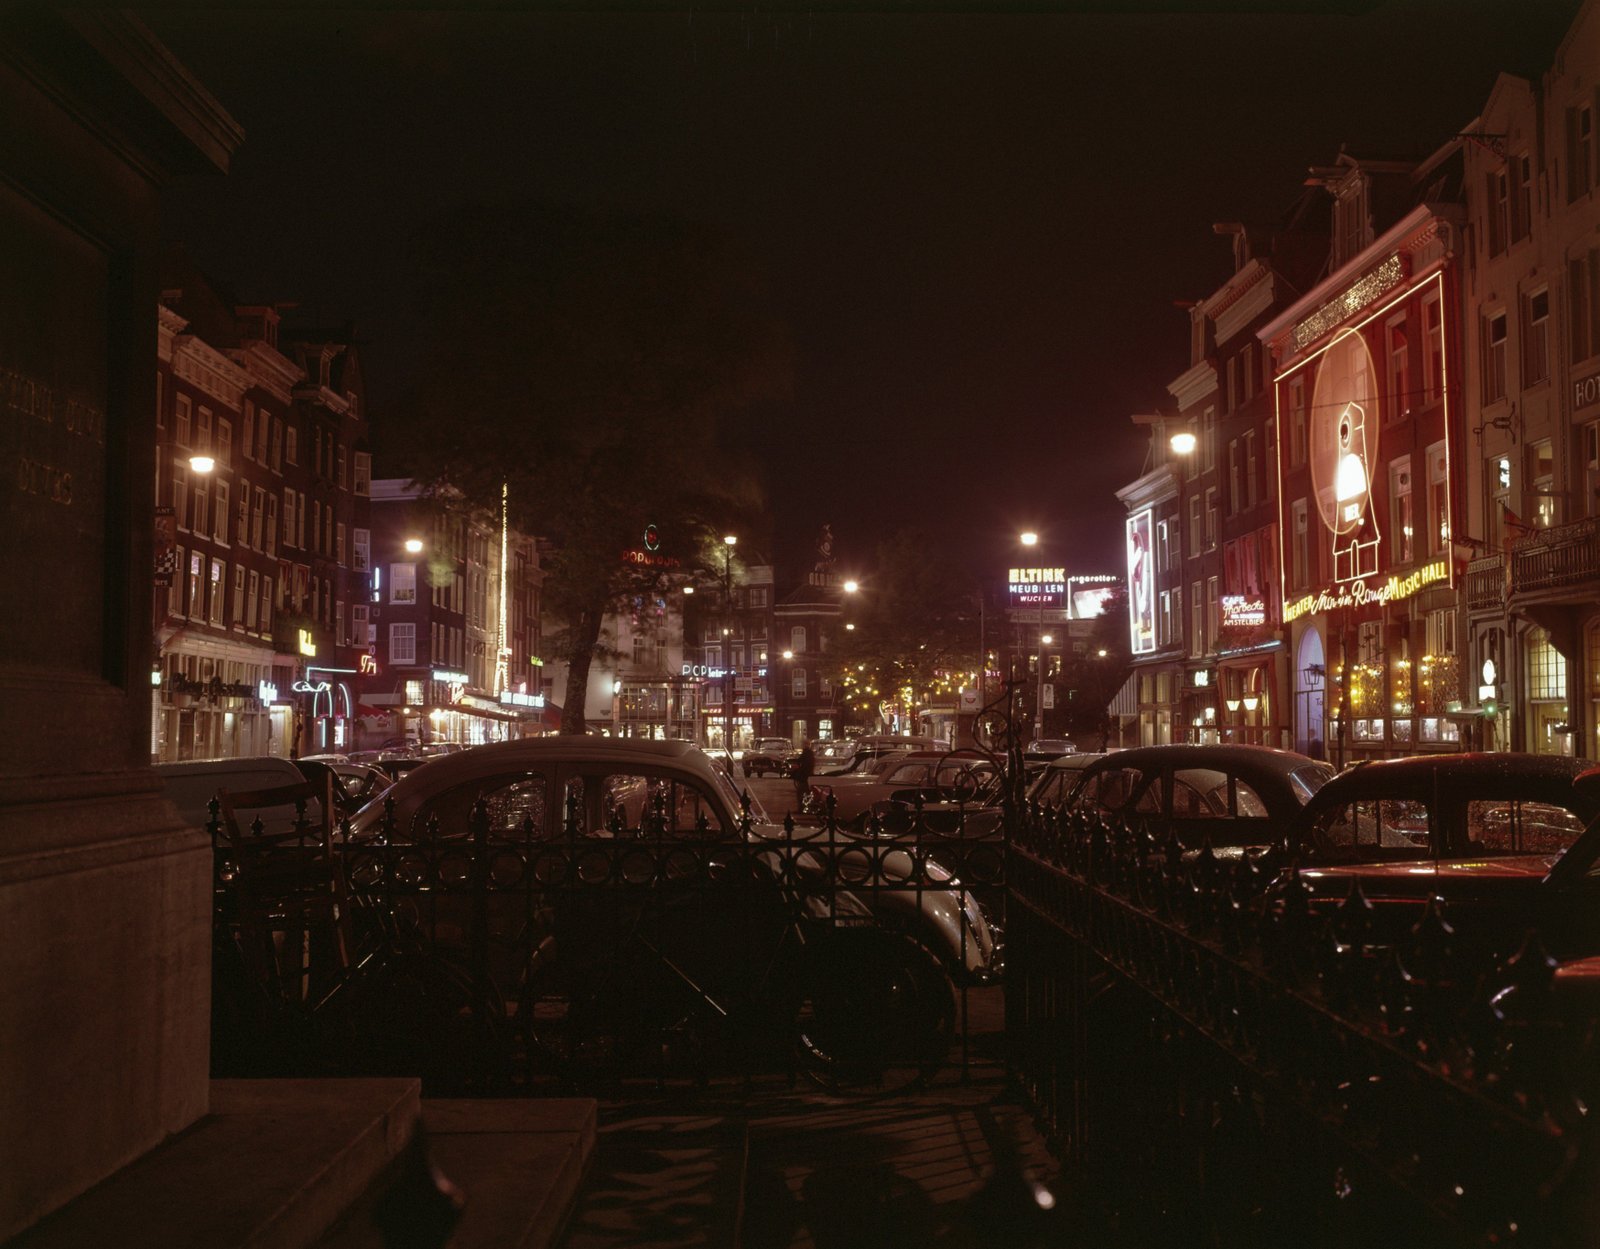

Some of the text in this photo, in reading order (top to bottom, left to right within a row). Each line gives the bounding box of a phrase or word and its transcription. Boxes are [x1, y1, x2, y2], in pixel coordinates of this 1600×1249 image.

[1009, 584, 1065, 594] MEUBLEN
[1282, 594, 1314, 624] THEATER
[1351, 579, 1391, 606] Rouge
[1420, 561, 1448, 585] HALL
